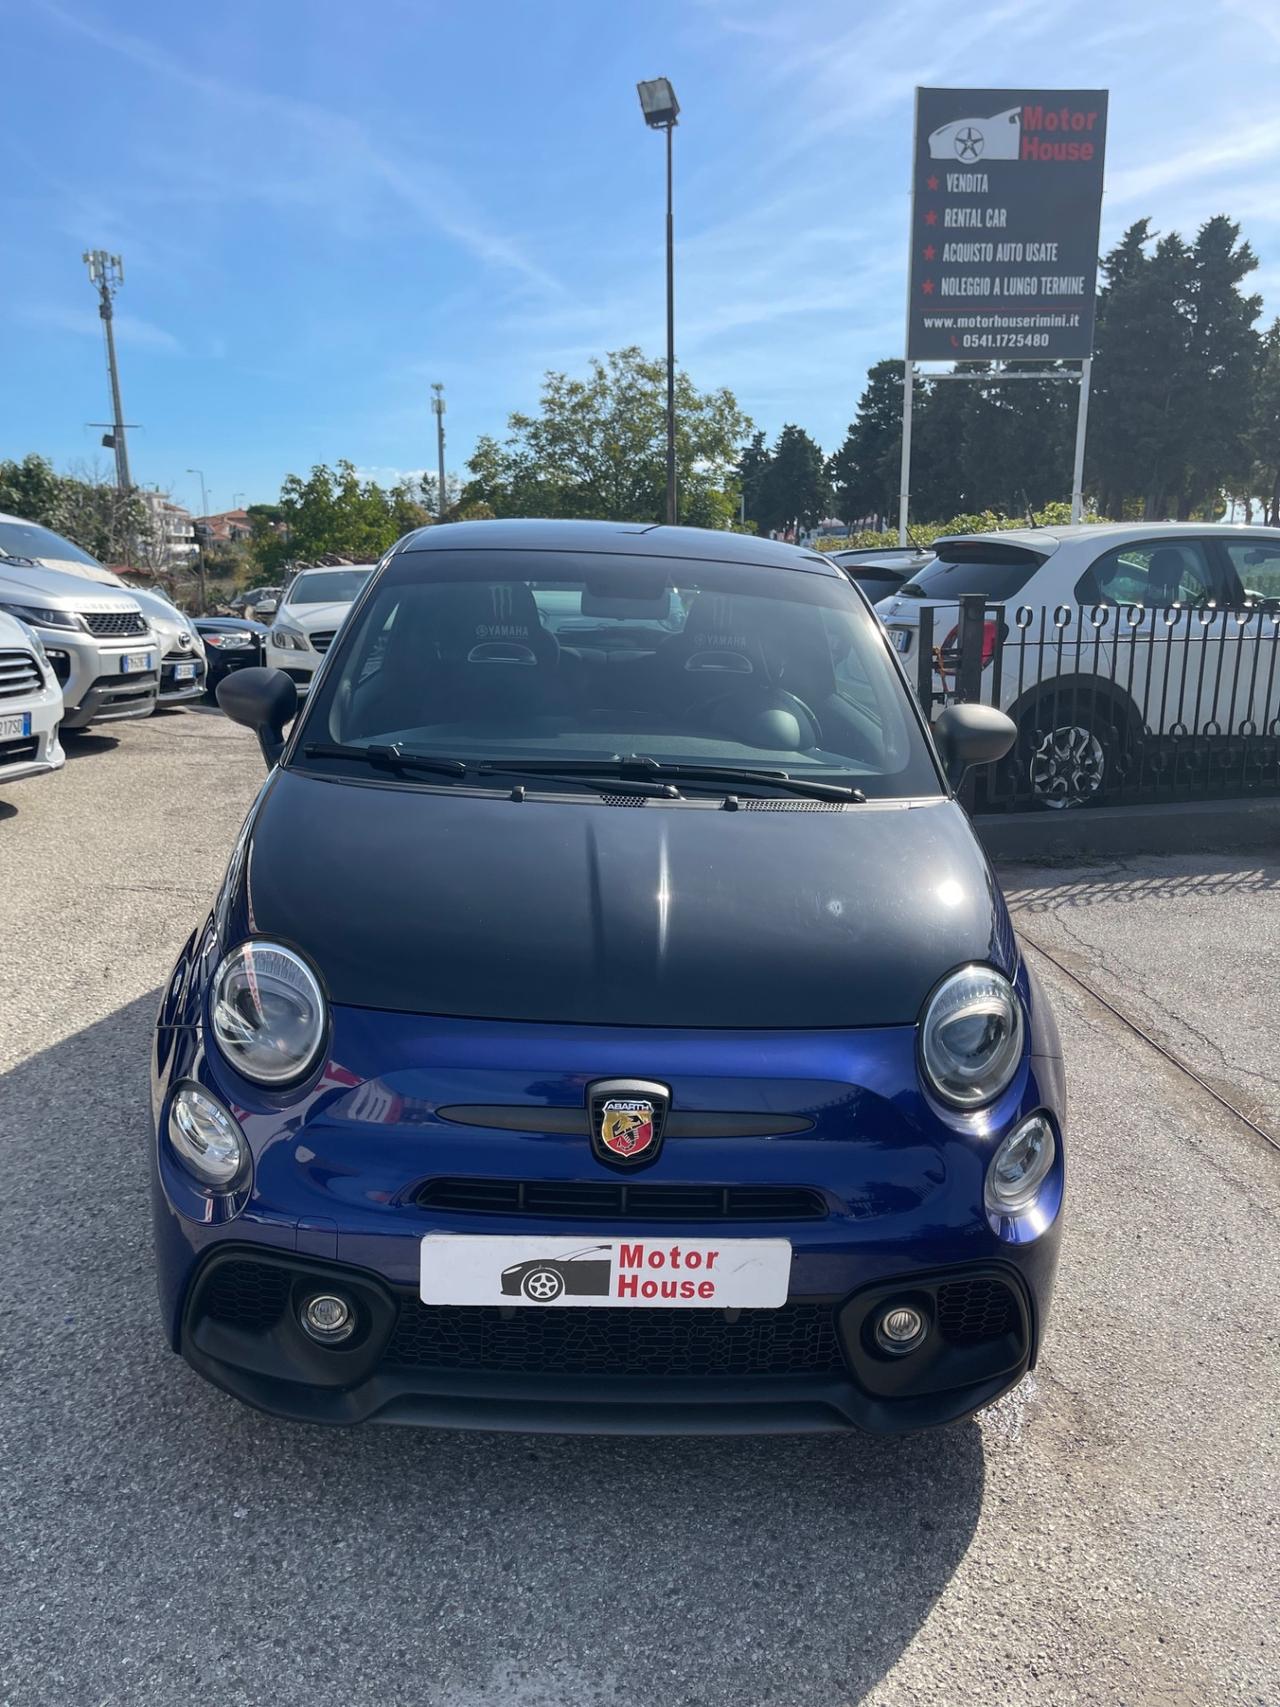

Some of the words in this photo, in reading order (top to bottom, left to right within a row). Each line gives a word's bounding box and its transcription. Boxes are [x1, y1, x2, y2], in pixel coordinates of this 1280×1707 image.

[1023, 106, 1097, 130] Motor
[1022, 136, 1094, 161] House
[946, 173, 989, 193] VENDITA
[944, 208, 983, 228] RENTAL
[985, 208, 1007, 228] CAR
[942, 242, 994, 263] ACQUISTO
[995, 242, 1024, 262] AUTO
[1025, 242, 1059, 262] USATE
[941, 277, 991, 297] NOLEGGIO
[992, 277, 1001, 296] A
[1003, 277, 1038, 296] LUNGO
[1040, 276, 1085, 295] TERMINE
[923, 313, 1080, 329] www.motorhouserimini.it
[962, 333, 1050, 348] 0541.1725480
[489, 624, 529, 637] YAMAHA
[707, 633, 747, 648] YAMAHA
[607, 1102, 650, 1112] ABARTH
[619, 1243, 720, 1270] Motor
[617, 1275, 716, 1300] House
